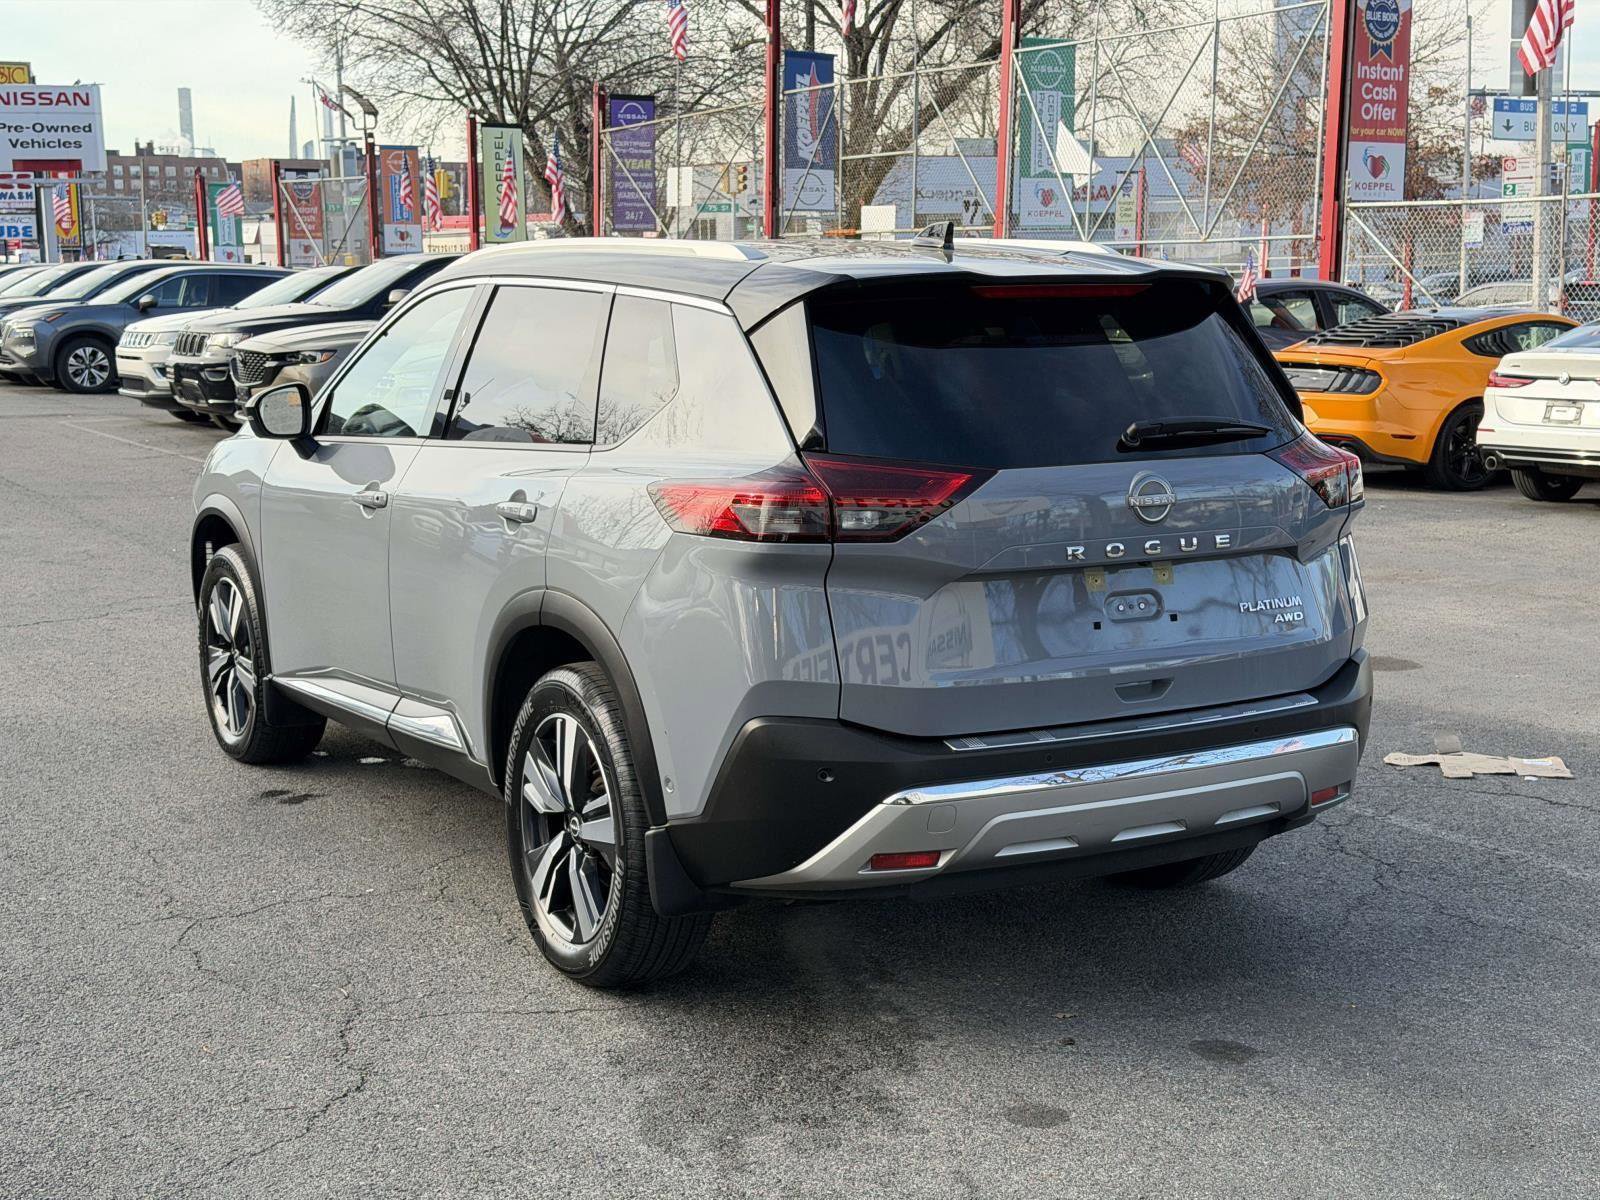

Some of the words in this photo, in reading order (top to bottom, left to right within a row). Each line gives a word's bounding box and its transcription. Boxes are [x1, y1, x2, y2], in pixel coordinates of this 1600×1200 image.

[1366, 10, 1382, 21] BLUE
[1382, 11, 1398, 22] BOOK
[1030, 65, 1067, 73] NISSAN
[1357, 61, 1404, 81] Instant
[1361, 82, 1397, 101] Cash
[0, 91, 91, 106] NISSAN
[1361, 102, 1396, 121] Offer
[1519, 102, 1534, 112] BUS
[0, 122, 93, 134] Pre-Owned
[1360, 127, 1375, 136] your
[1376, 128, 1386, 136] car
[8, 138, 83, 149] Vehicles
[625, 159, 652, 170] YEAR
[1354, 182, 1395, 191] KOEPPEL
[1505, 185, 1514, 195] 2
[0, 191, 33, 200] WASH
[625, 210, 644, 220] 24/7
[1027, 210, 1065, 218] KOEPPEL
[1130, 495, 1175, 506] NISSAN
[1066, 534, 1231, 561] ROGUE
[1239, 595, 1303, 613] PLATINUM
[1274, 611, 1304, 624] AWD
[504, 696, 534, 807] BRIDGESTONE
[588, 855, 625, 968] BRIDGESTONE
